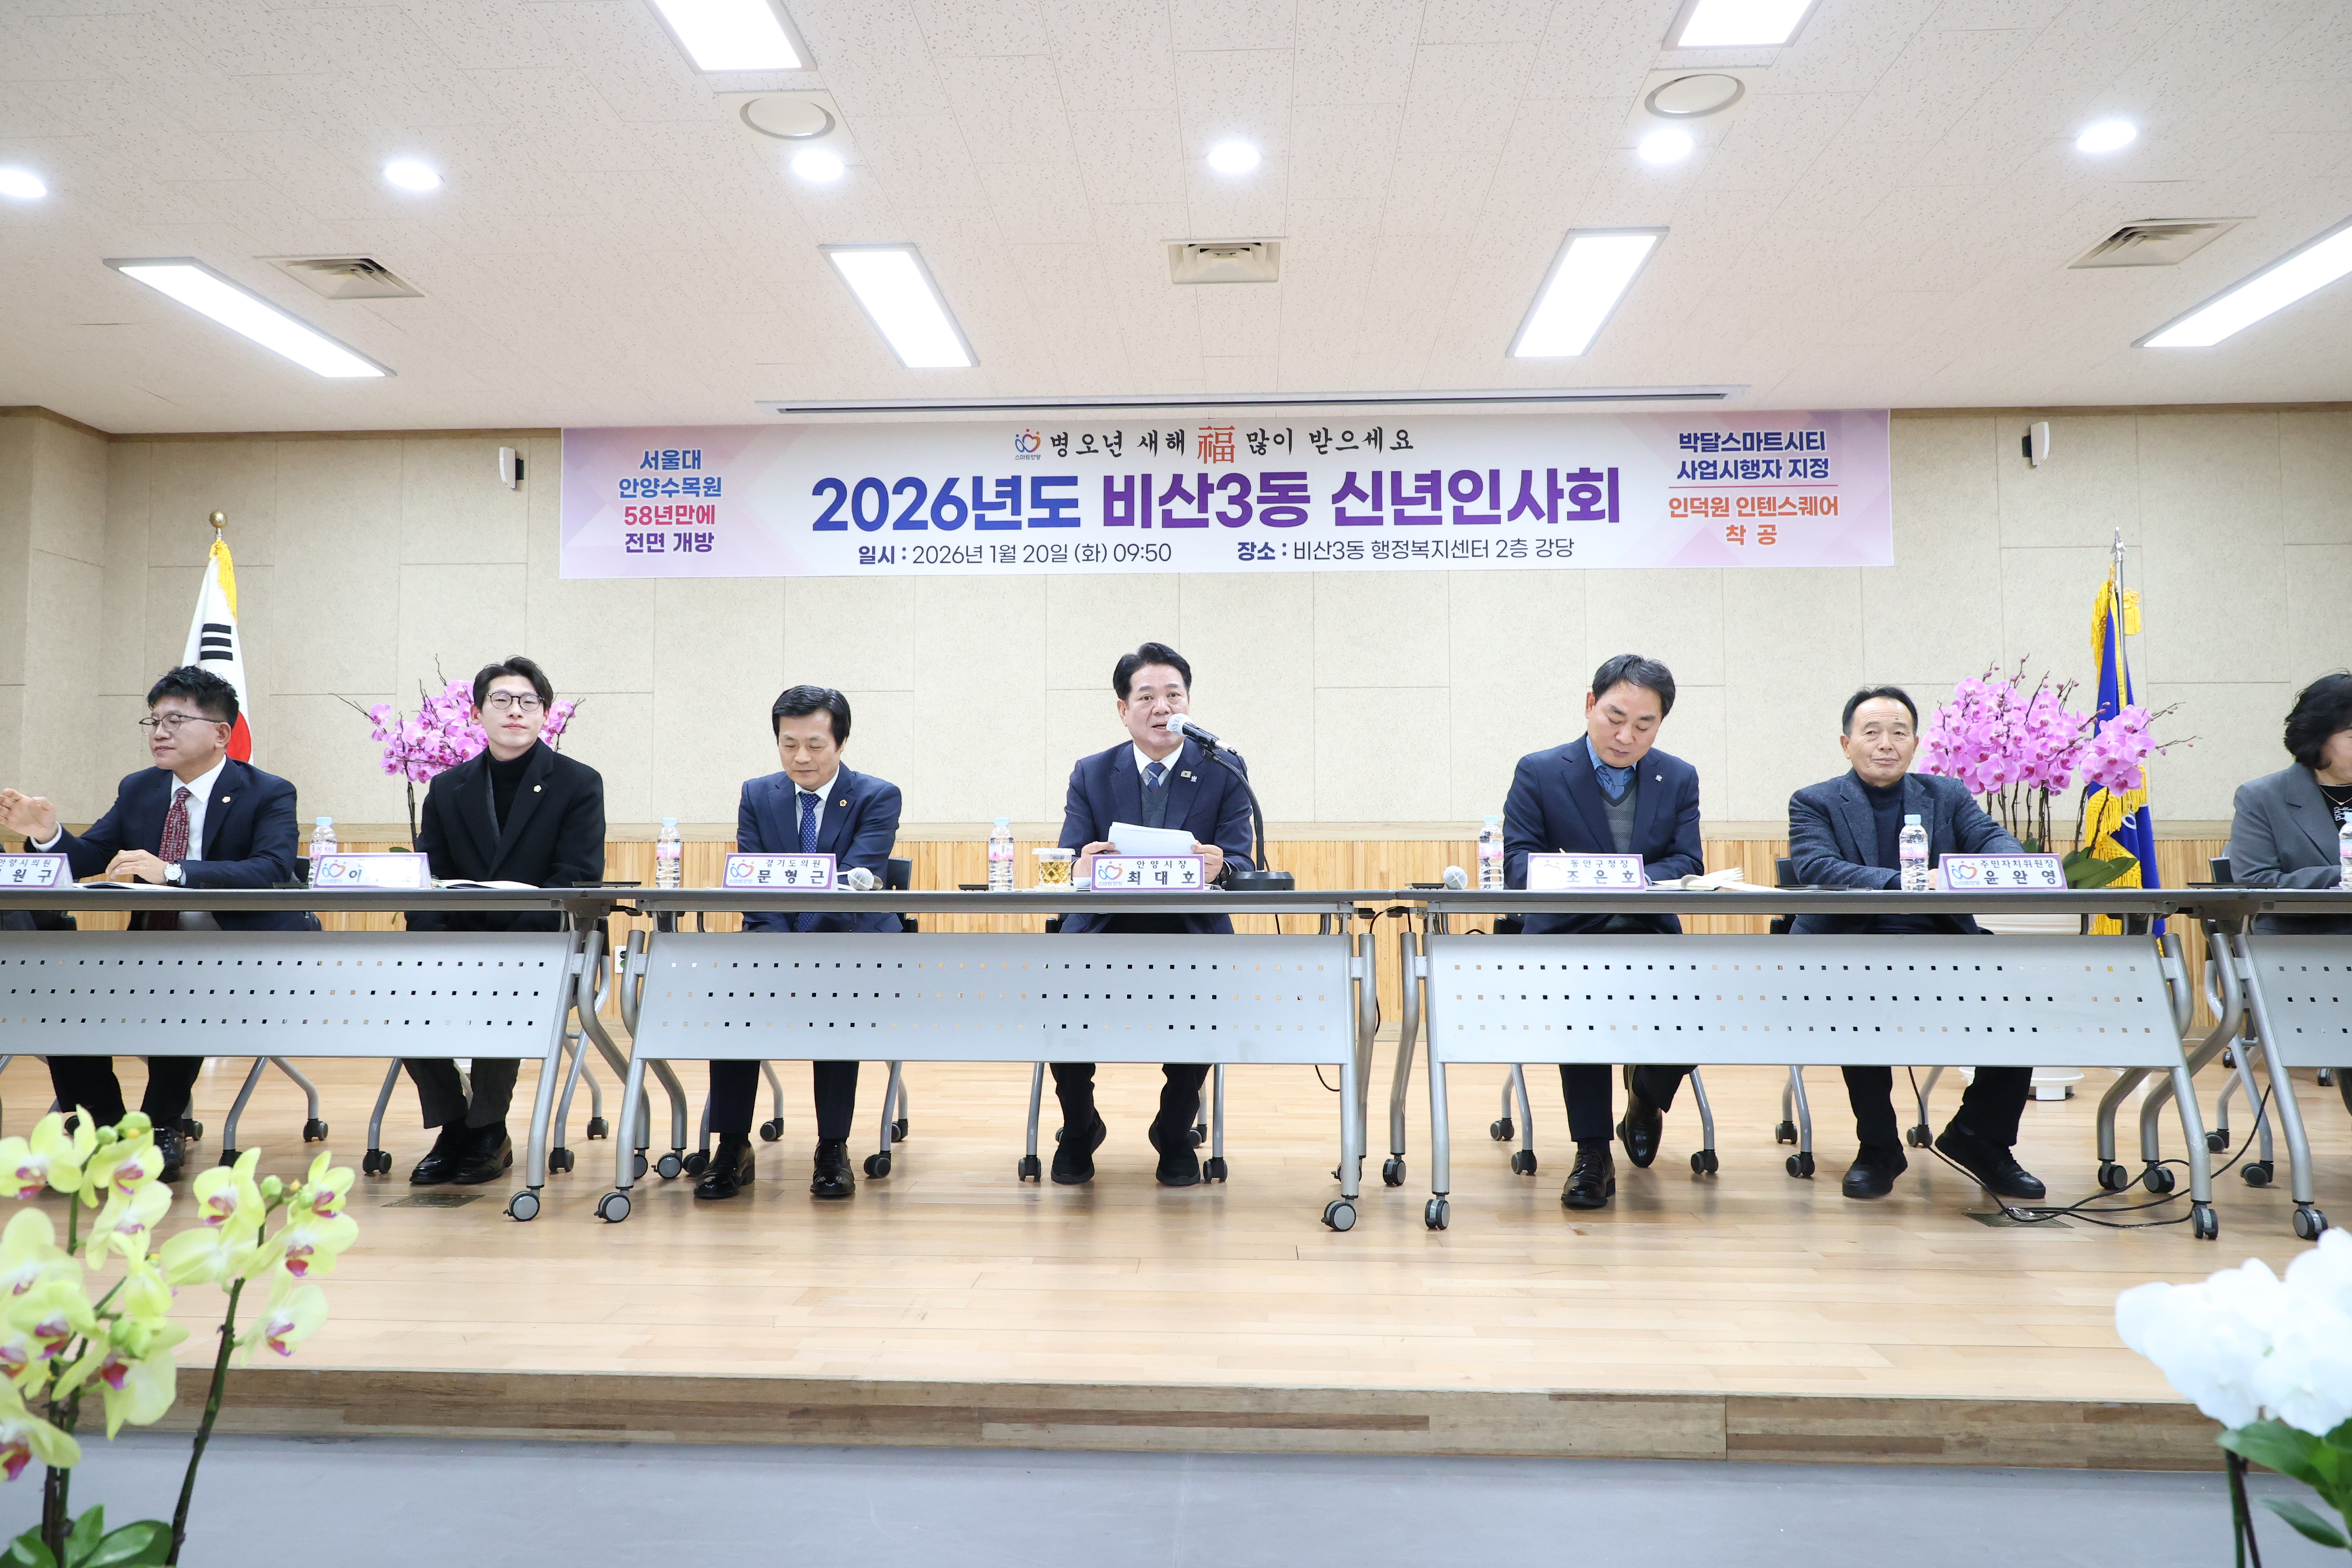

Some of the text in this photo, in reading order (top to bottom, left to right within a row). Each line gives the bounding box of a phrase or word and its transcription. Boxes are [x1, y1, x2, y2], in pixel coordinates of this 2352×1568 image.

[1050, 425, 1414, 464] 병오년 새해 福 많이 받으세요
[1679, 431, 1826, 453] 박달스마트시티
[640, 449, 701, 470] 서울대
[1677, 458, 1829, 480] 사업시행자 지정
[619, 476, 721, 499] 안양수목원
[812, 467, 1620, 532] 2026년도 비산3동 신년인사회
[1668, 495, 1838, 518] 인덕원 인텐스퀘어
[624, 505, 715, 526] 58년만에
[625, 532, 715, 553] 전면 개방
[1294, 540, 1365, 561] 비산3동
[1371, 539, 1488, 559] 행정복지센터
[1495, 538, 1528, 558] 2층
[1535, 538, 1575, 558] 강당
[913, 545, 982, 564] 2026년
[989, 544, 1016, 563] 1월
[1023, 544, 1067, 563] 20일
[1075, 543, 1108, 563] (화)
[1114, 543, 1172, 562] 09:50
[766, 859, 821, 868] 경기도의원
[1137, 860, 1187, 869] 안양시장
[1571, 859, 1629, 869] 동안구청장
[1980, 859, 2053, 869] 주민자치위원장
